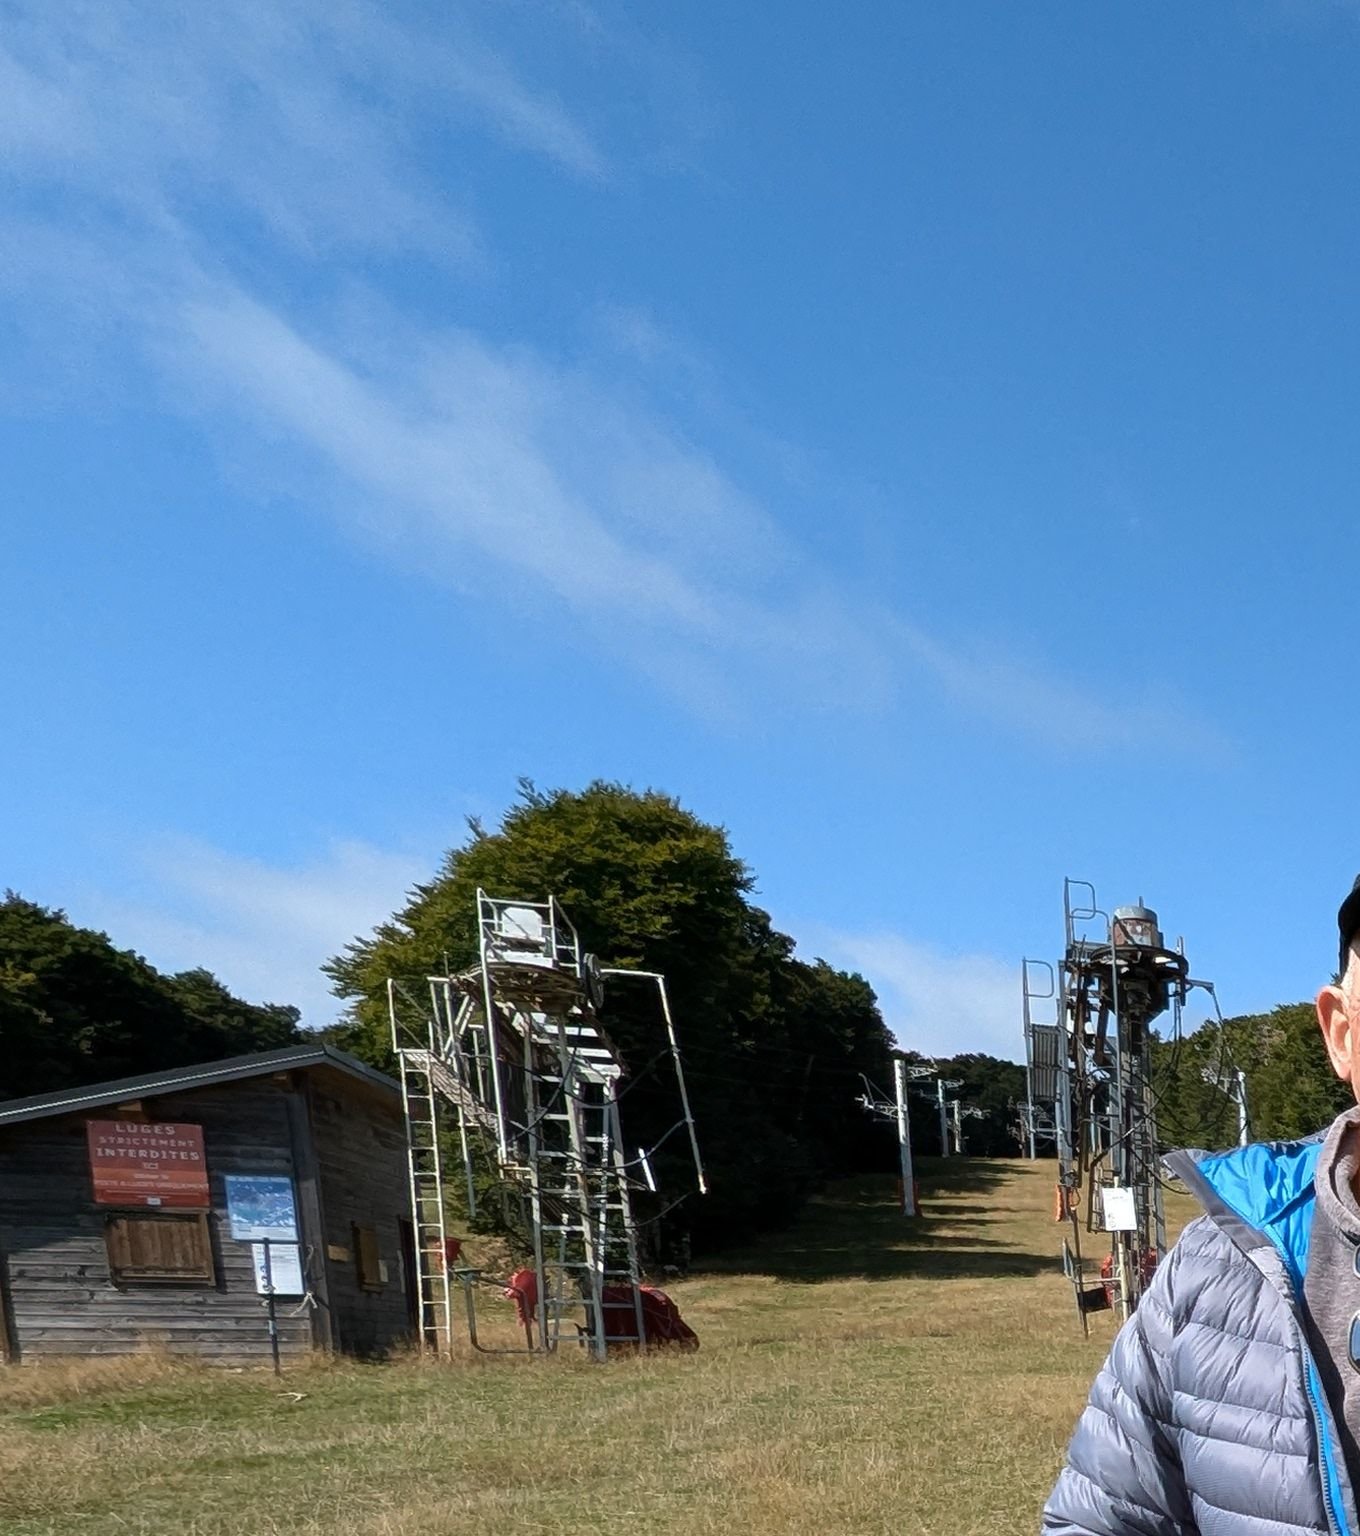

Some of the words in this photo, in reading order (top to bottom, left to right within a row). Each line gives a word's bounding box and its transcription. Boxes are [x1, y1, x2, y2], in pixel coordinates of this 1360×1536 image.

[115, 1124, 176, 1135] LUGES
[99, 1136, 195, 1147] STRICTEMENT
[96, 1147, 200, 1160] INTERDITES
